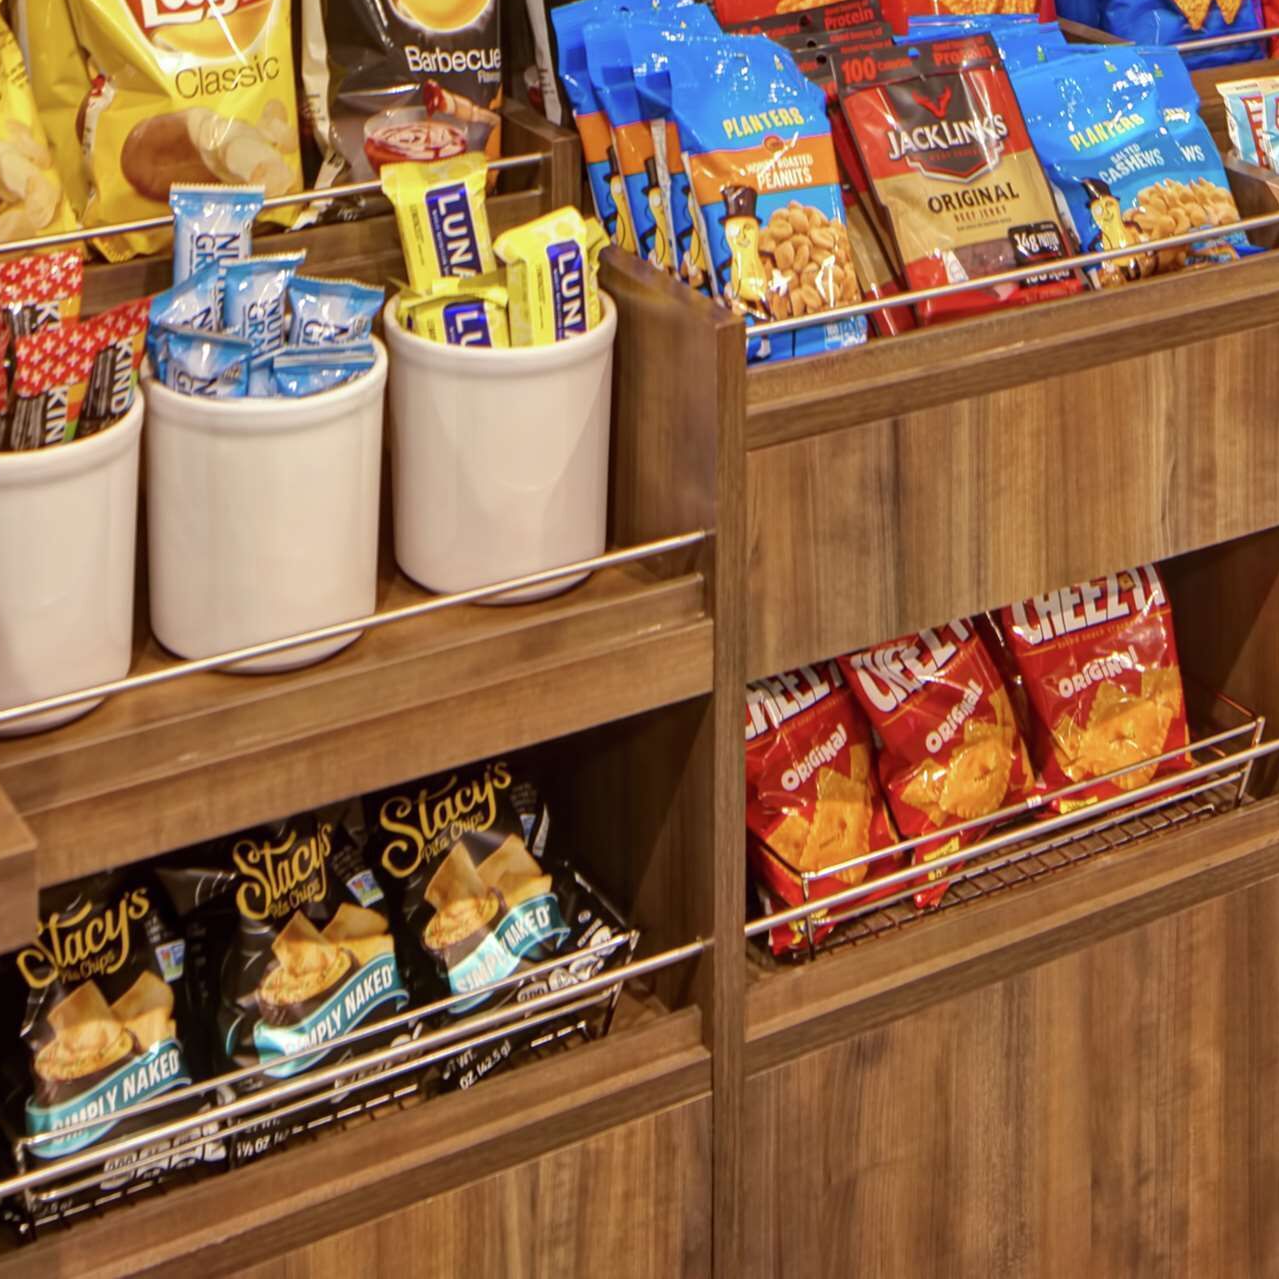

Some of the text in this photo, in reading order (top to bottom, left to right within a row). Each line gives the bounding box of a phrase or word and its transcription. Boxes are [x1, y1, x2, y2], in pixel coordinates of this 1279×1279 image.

[824, 8, 874, 31] Protein
[175, 55, 281, 101] Classic
[405, 45, 501, 73] Barbecue
[841, 56, 877, 84] 100
[722, 107, 806, 140] PLANTERS
[1068, 114, 1145, 152] PLANTERS
[887, 124, 944, 162] JACK
[756, 168, 813, 191] PEANUTS
[1098, 146, 1165, 185] CASHEWS
[926, 182, 1020, 215] ORIGINAL
[110, 340, 134, 412] KIND
[46, 386, 68, 443] KIN
[380, 761, 512, 879] Stacy's
[449, 810, 485, 838] Chips
[233, 822, 333, 921] Stacy's
[289, 882, 323, 909] Chips
[17, 884, 151, 990] Stacy's
[506, 906, 552, 956] NAKED
[80, 949, 116, 981] Chips
[344, 966, 395, 1017] NAKED
[121, 1053, 180, 1102] NAKED
